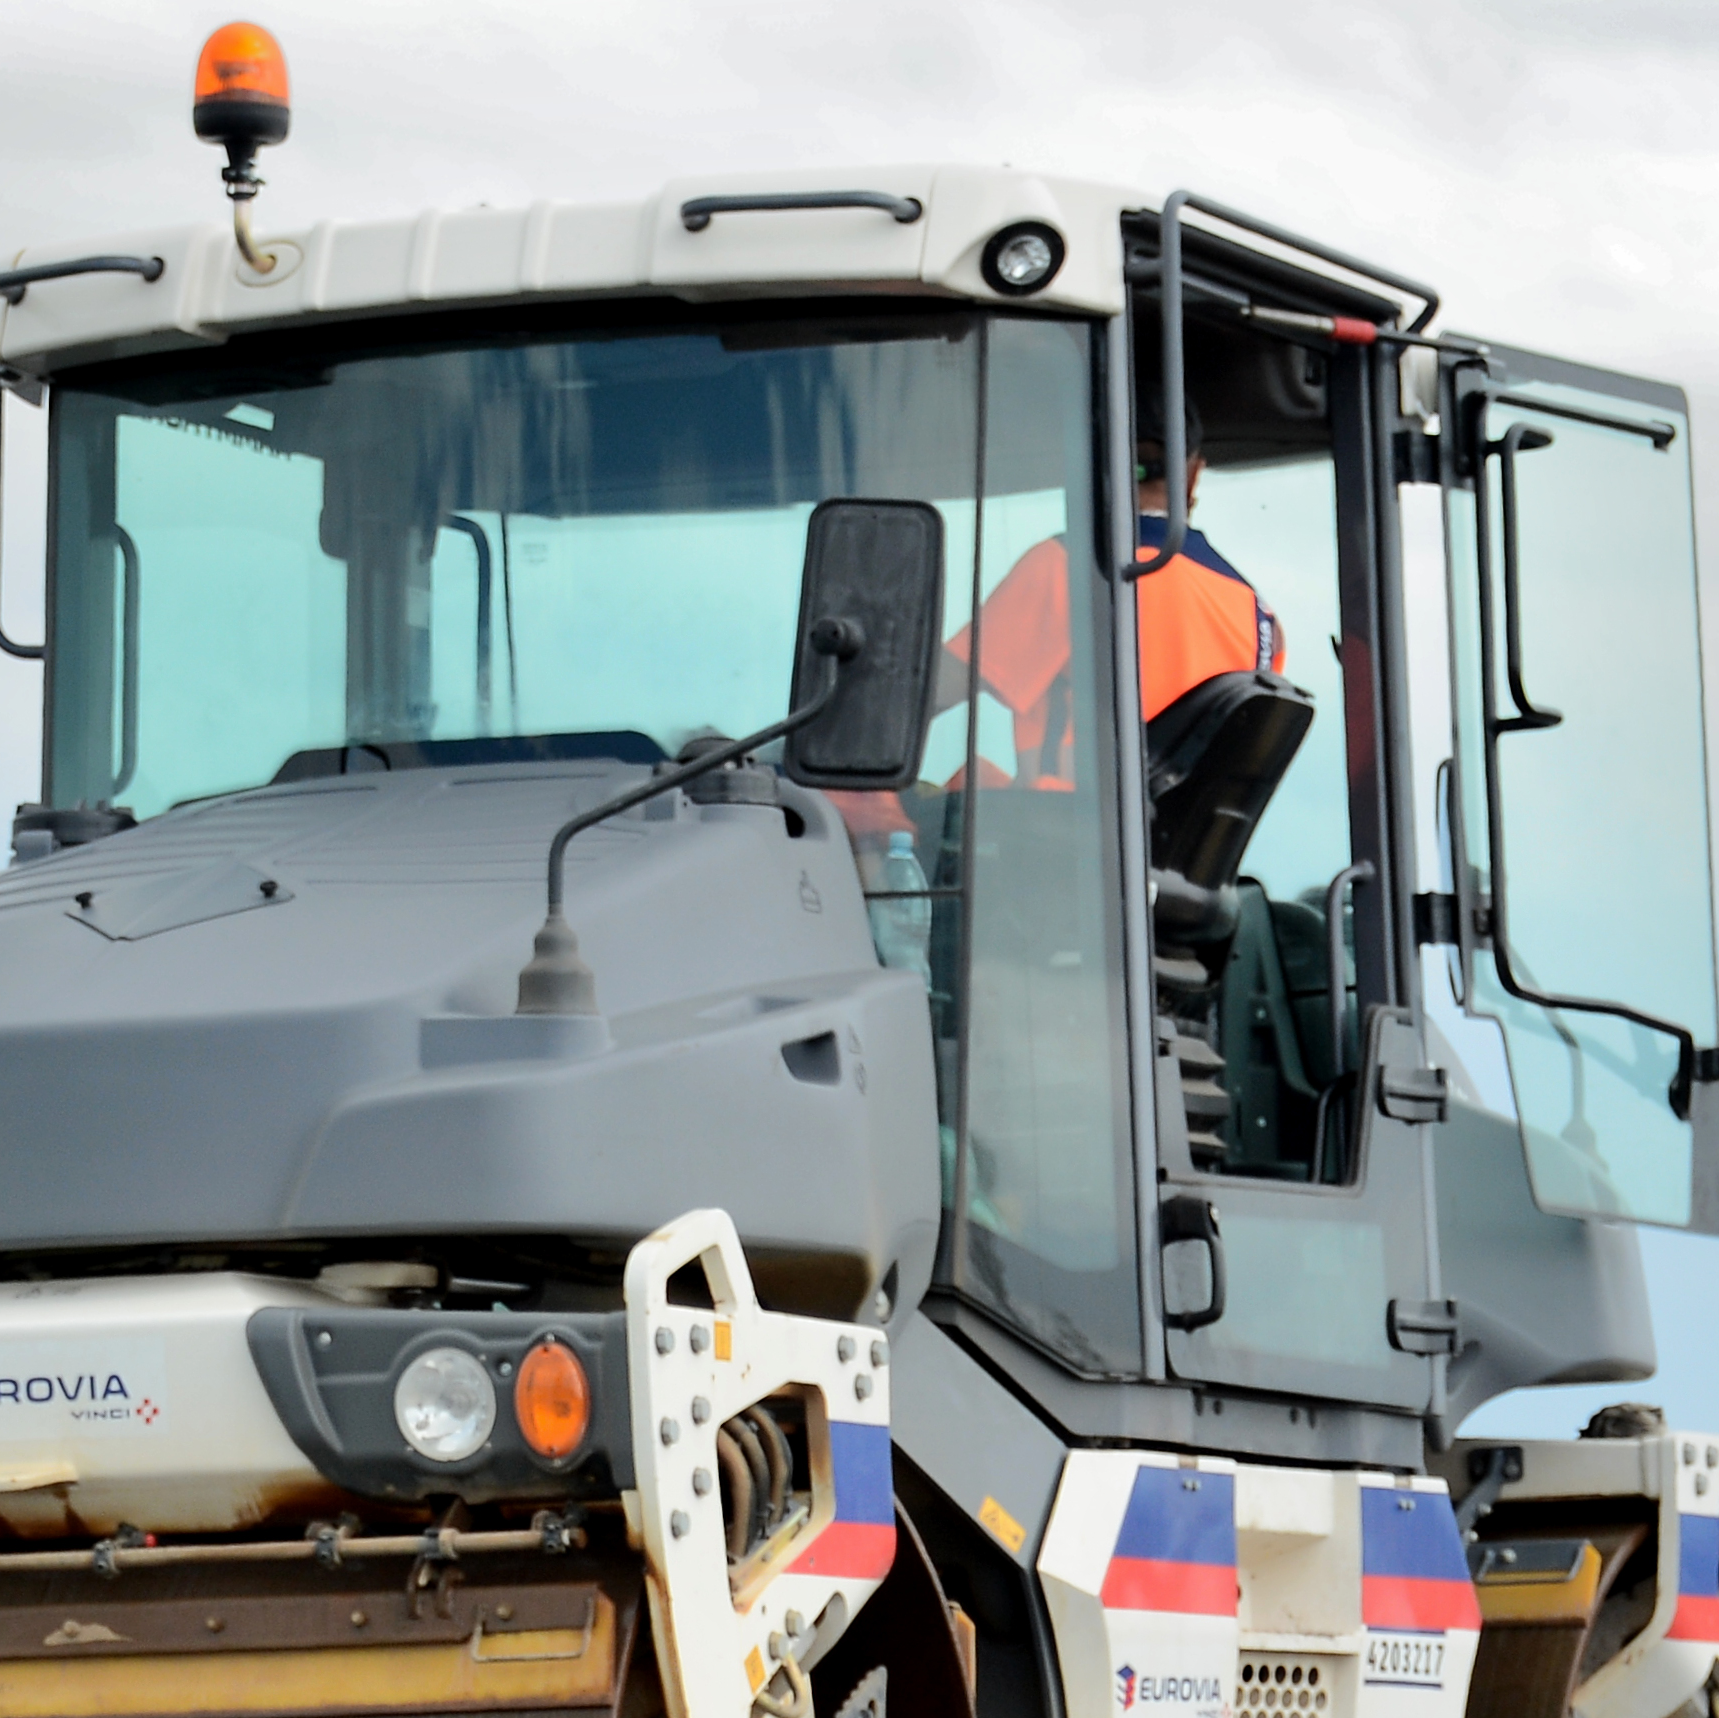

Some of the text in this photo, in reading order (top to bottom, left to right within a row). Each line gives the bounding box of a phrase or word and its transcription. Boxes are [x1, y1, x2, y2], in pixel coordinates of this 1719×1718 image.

[70, 1408, 130, 1420] VINCI
[1367, 1641, 1445, 1675] 4203217
[1140, 1677, 1220, 1701] EUROVIA
